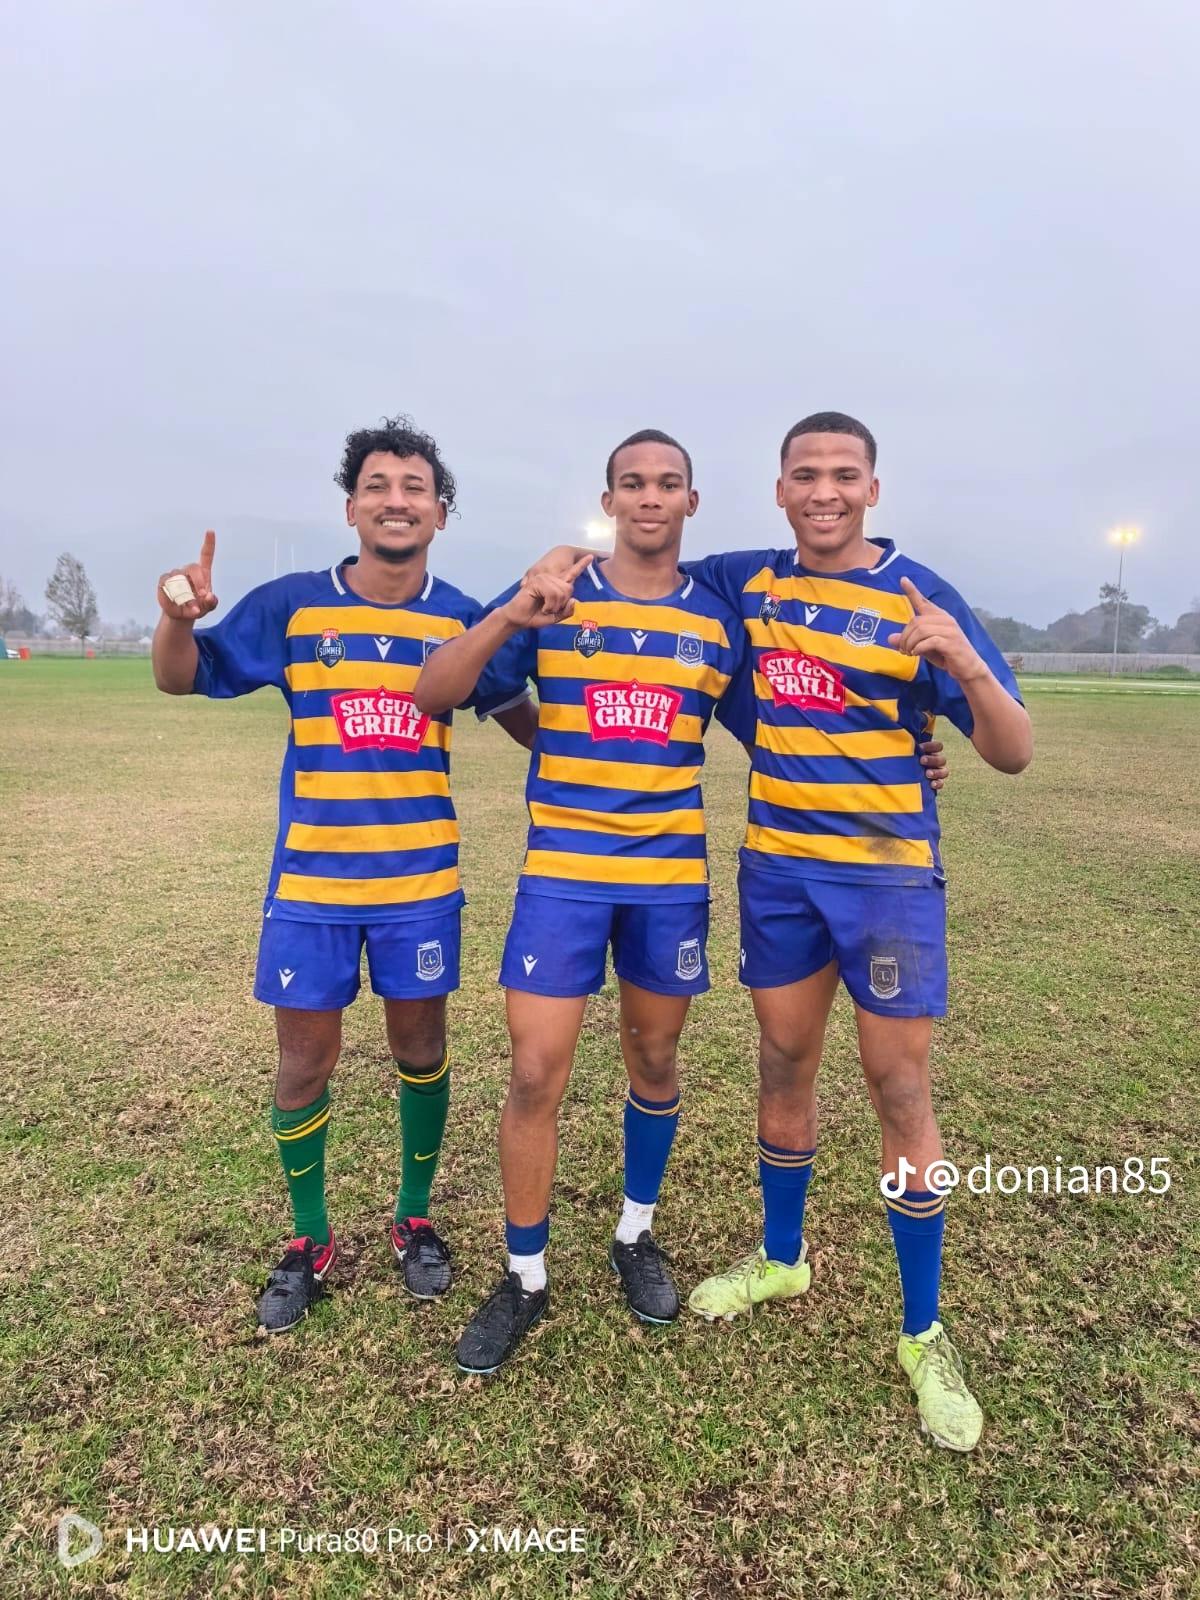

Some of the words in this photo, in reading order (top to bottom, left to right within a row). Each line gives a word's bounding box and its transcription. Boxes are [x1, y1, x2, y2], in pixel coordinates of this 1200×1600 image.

[319, 646, 341, 656] SUMMER
[766, 657, 795, 675] SIX
[768, 675, 841, 702] GRILL
[339, 697, 376, 717] SIX
[377, 698, 423, 721] GUN
[592, 690, 628, 707] SIX
[629, 690, 674, 712] GUN
[344, 714, 421, 741] GRILL
[595, 706, 669, 734] GRILL
